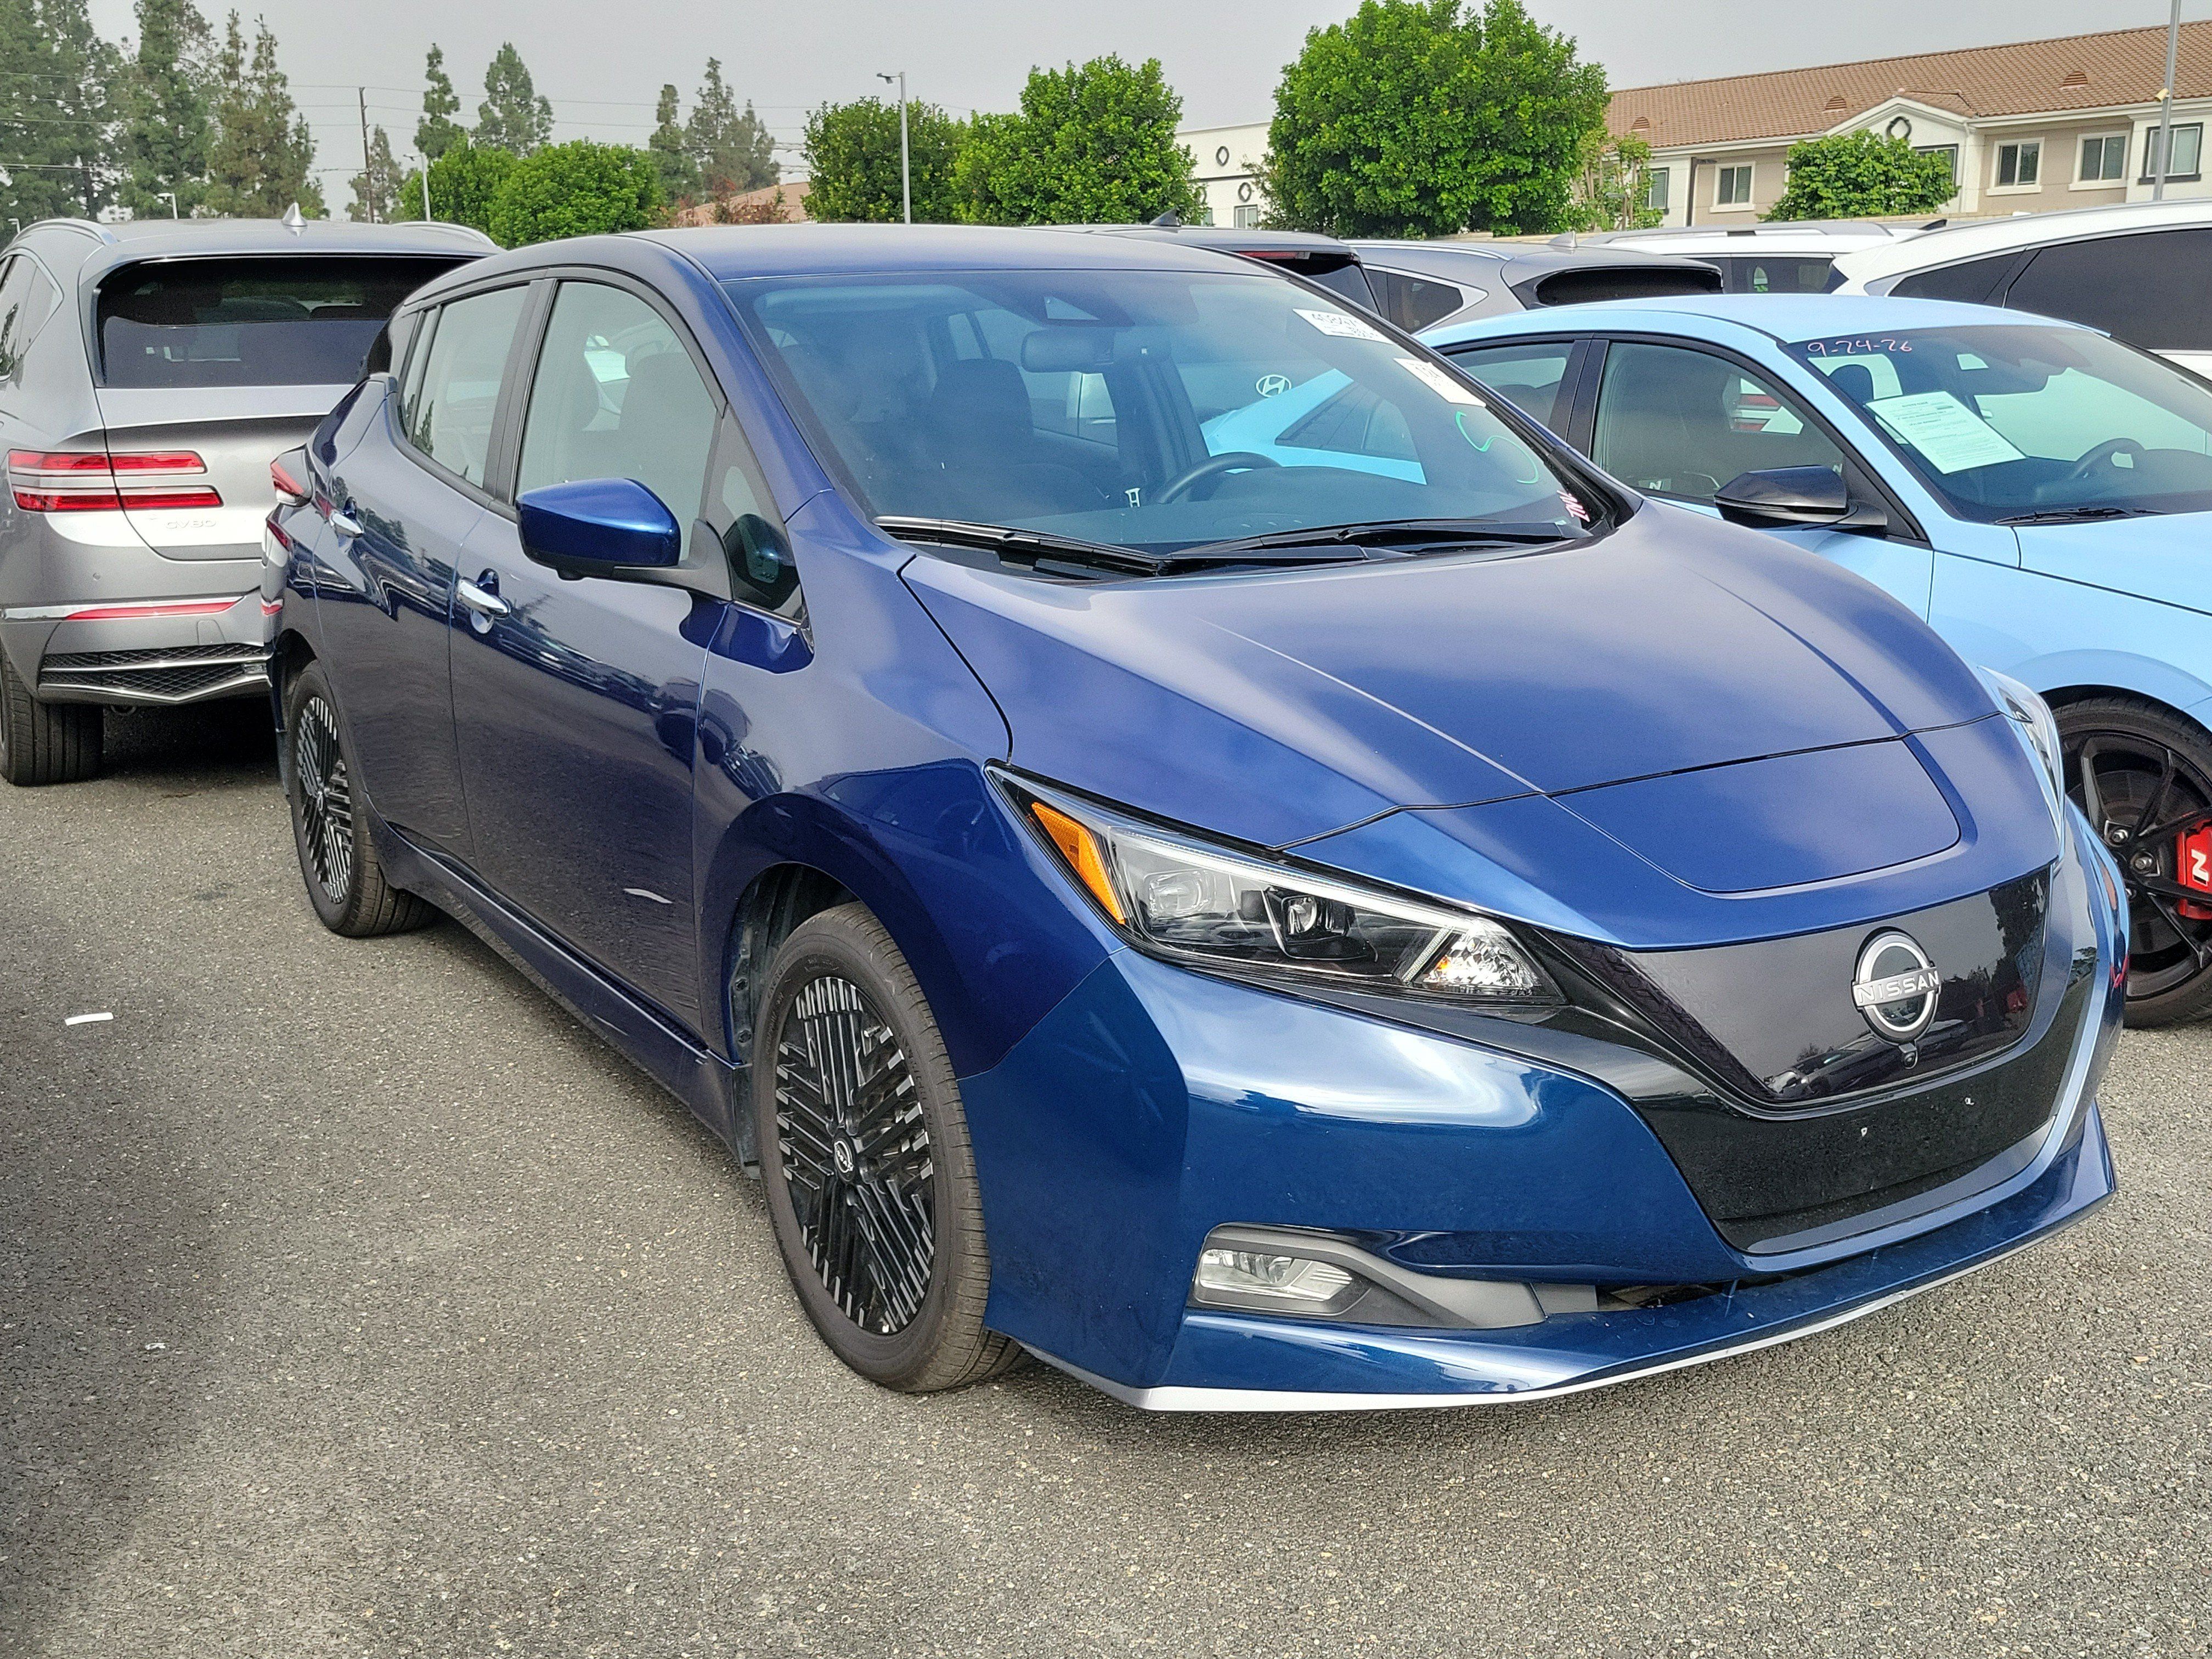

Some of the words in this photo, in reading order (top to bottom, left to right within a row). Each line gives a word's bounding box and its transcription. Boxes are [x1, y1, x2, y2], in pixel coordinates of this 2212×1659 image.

[1807, 339, 1912, 357] 9-24-26
[164, 520, 217, 529] GV80
[1857, 970, 1940, 1004] NISSAN
